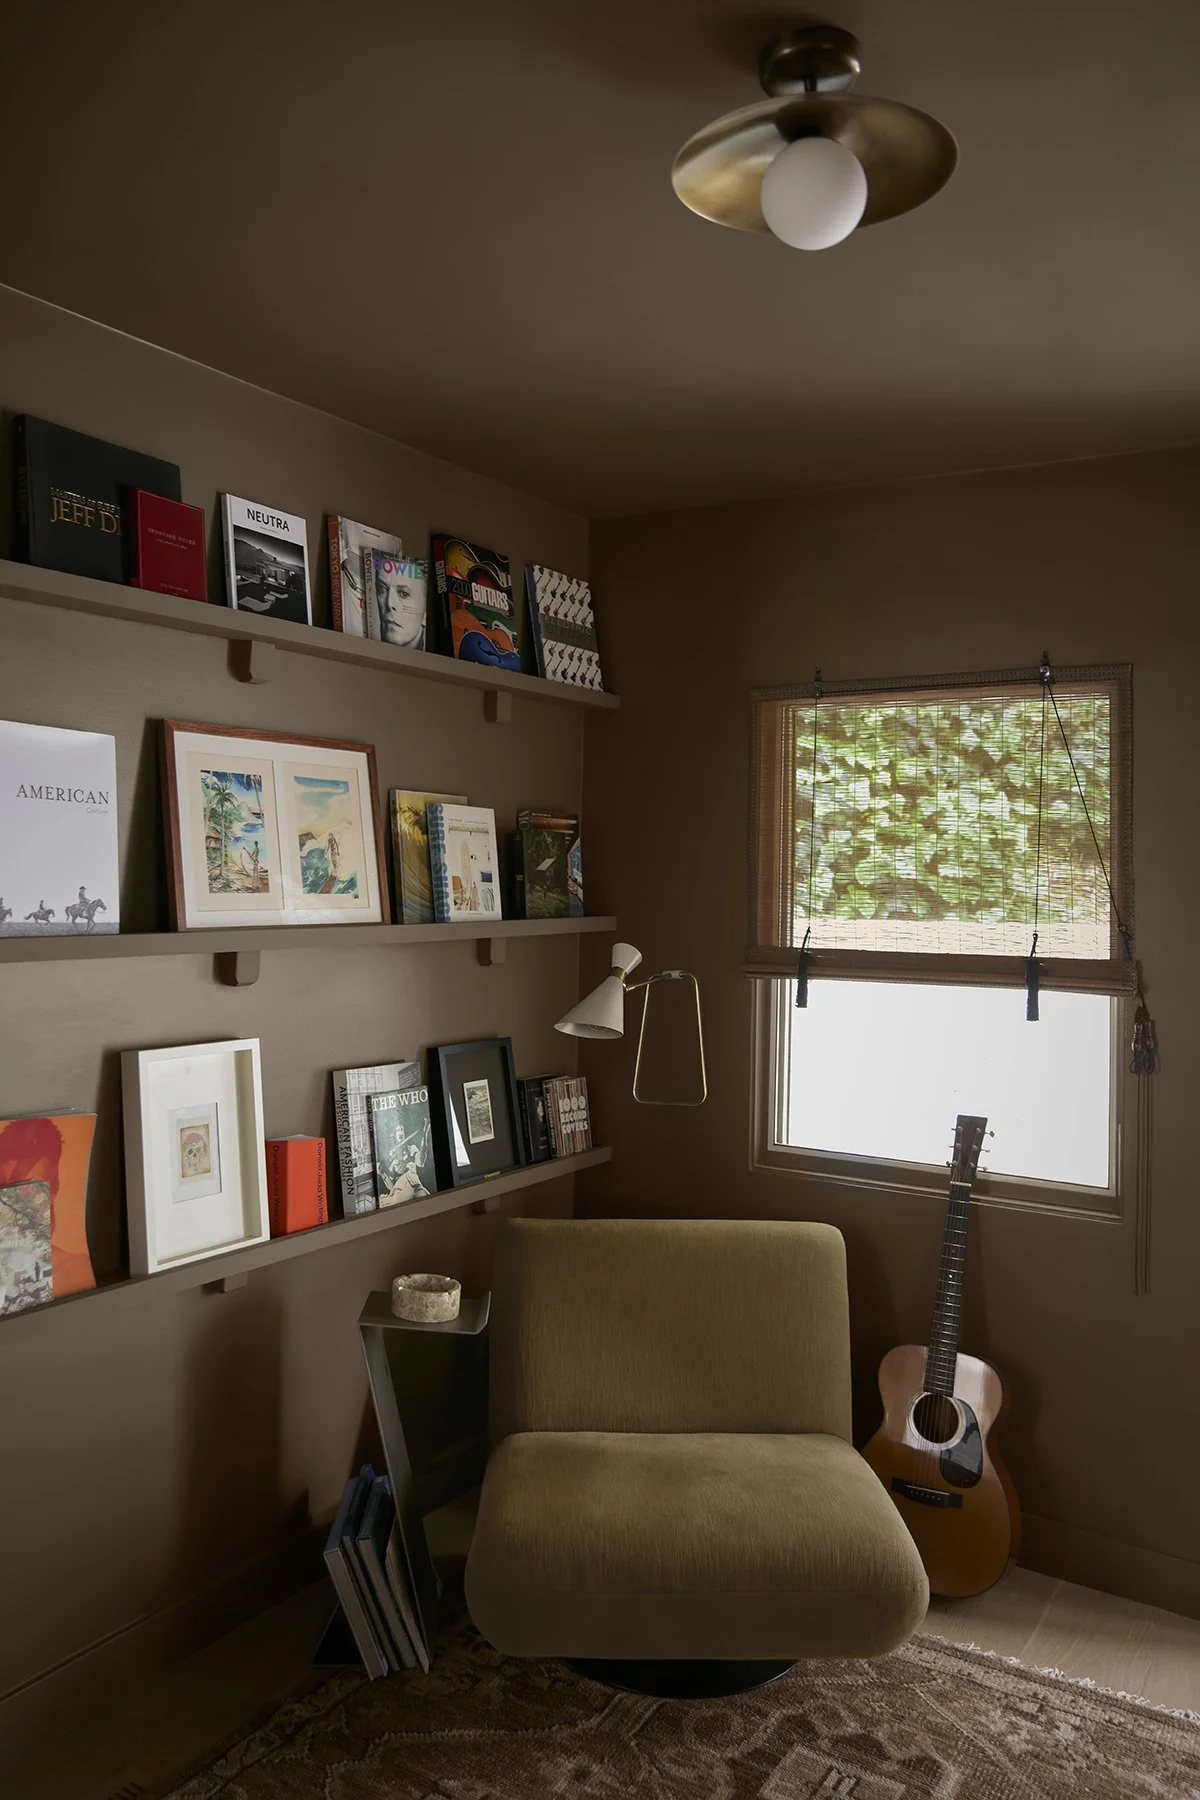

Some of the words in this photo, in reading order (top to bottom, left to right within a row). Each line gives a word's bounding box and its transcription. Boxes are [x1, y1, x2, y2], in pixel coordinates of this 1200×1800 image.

[49, 497, 95, 527] JEFF
[247, 508, 290, 532] NEUTRA
[330, 537, 339, 574] TOKYO
[364, 552, 373, 584] BOWIE
[373, 555, 426, 580] BOWIE
[434, 561, 447, 594] GUITARS
[471, 582, 509, 611] GUITARS
[16, 784, 110, 804] AMERICAN
[338, 1086, 351, 1143] AMERICAN
[371, 1095, 397, 1112] THE
[397, 1089, 428, 1107] WHO
[335, 1099, 345, 1144] DESIGNERS
[562, 1121, 588, 1134] COVERS
[271, 1145, 280, 1175] Donald
[316, 1142, 324, 1171] Donald
[339, 1146, 346, 1157] AT
[272, 1175, 281, 1196] Judd
[316, 1171, 324, 1193] Judd
[344, 1146, 355, 1196] FASHION
[317, 1193, 326, 1225] Writing
